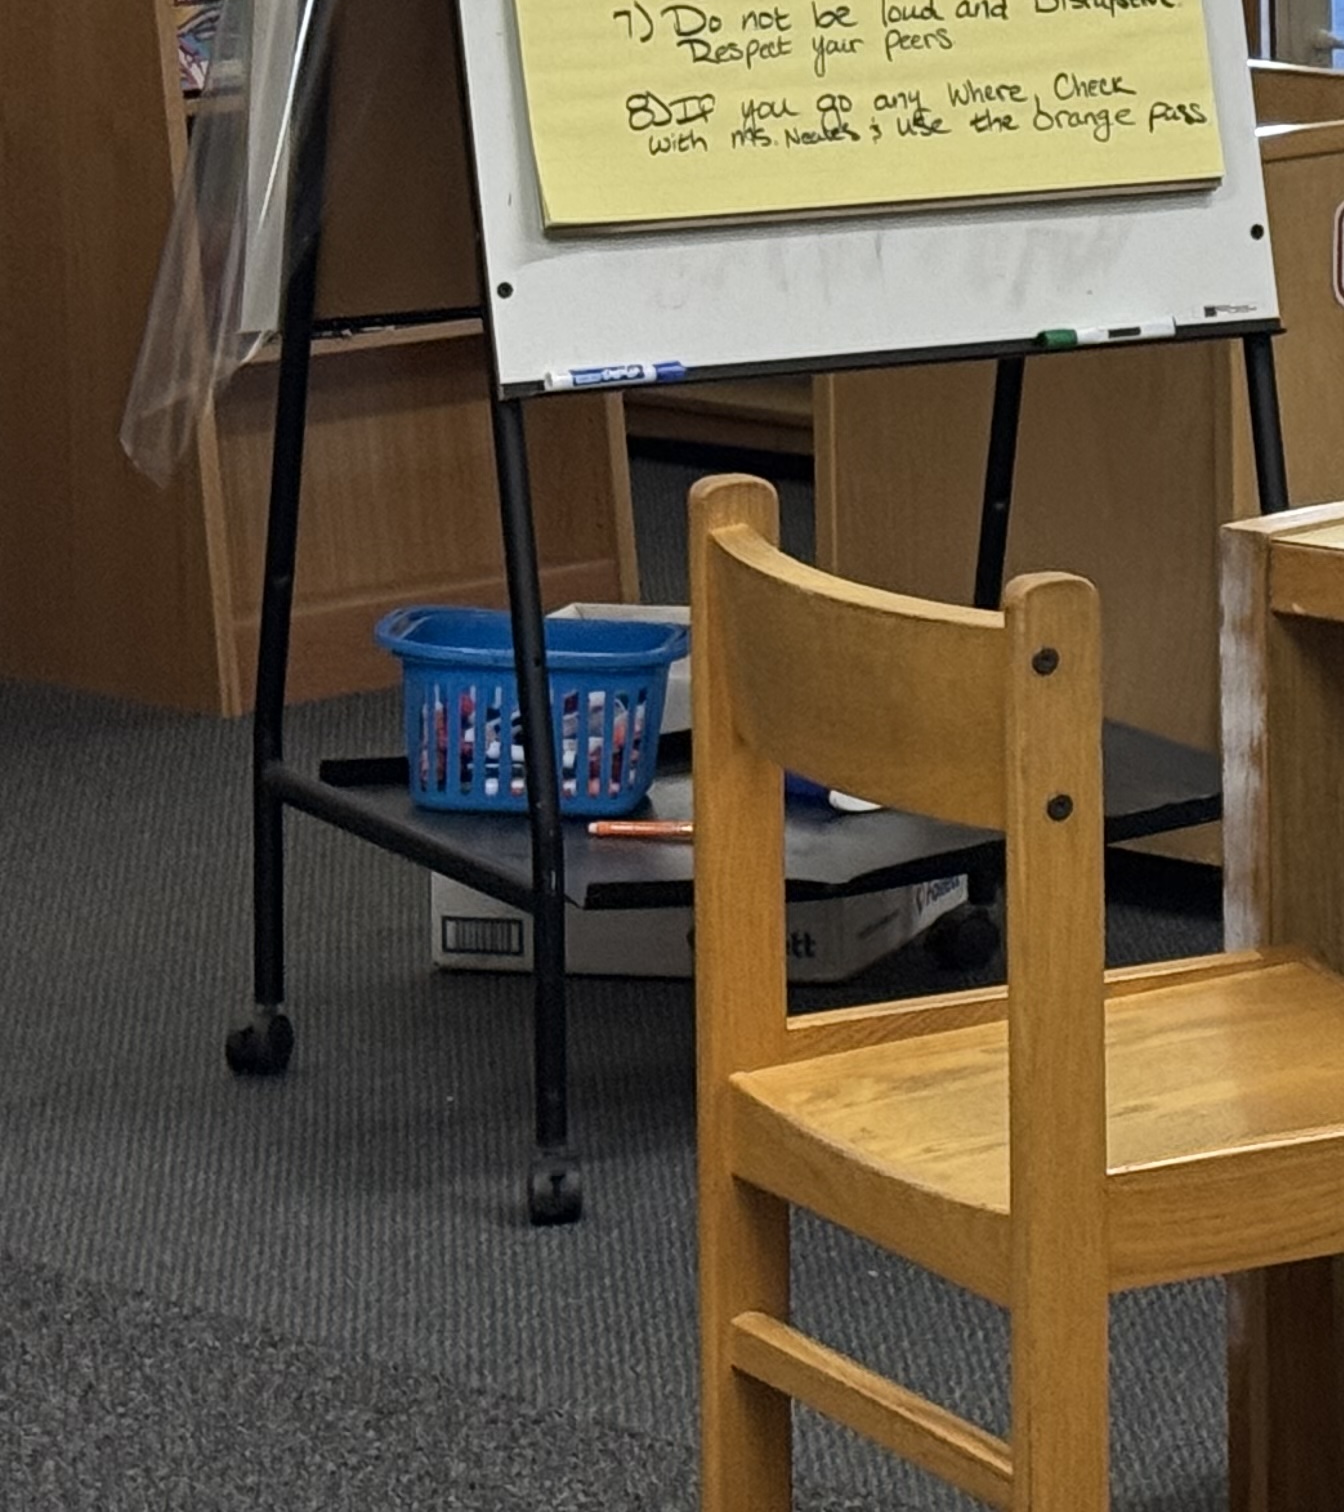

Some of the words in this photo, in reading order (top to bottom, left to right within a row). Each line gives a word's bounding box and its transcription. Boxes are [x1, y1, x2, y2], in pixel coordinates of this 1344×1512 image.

[613, 0, 654, 43] 7)
[660, 4, 723, 37] Do
[741, 5, 793, 33] not
[811, 0, 859, 29] be
[626, 90, 673, 131] 8)
[668, 93, 716, 125] If
[741, 97, 800, 138] you
[816, 93, 853, 128] go
[873, 89, 925, 118] any
[648, 131, 709, 157] with
[968, 104, 1021, 134] the
